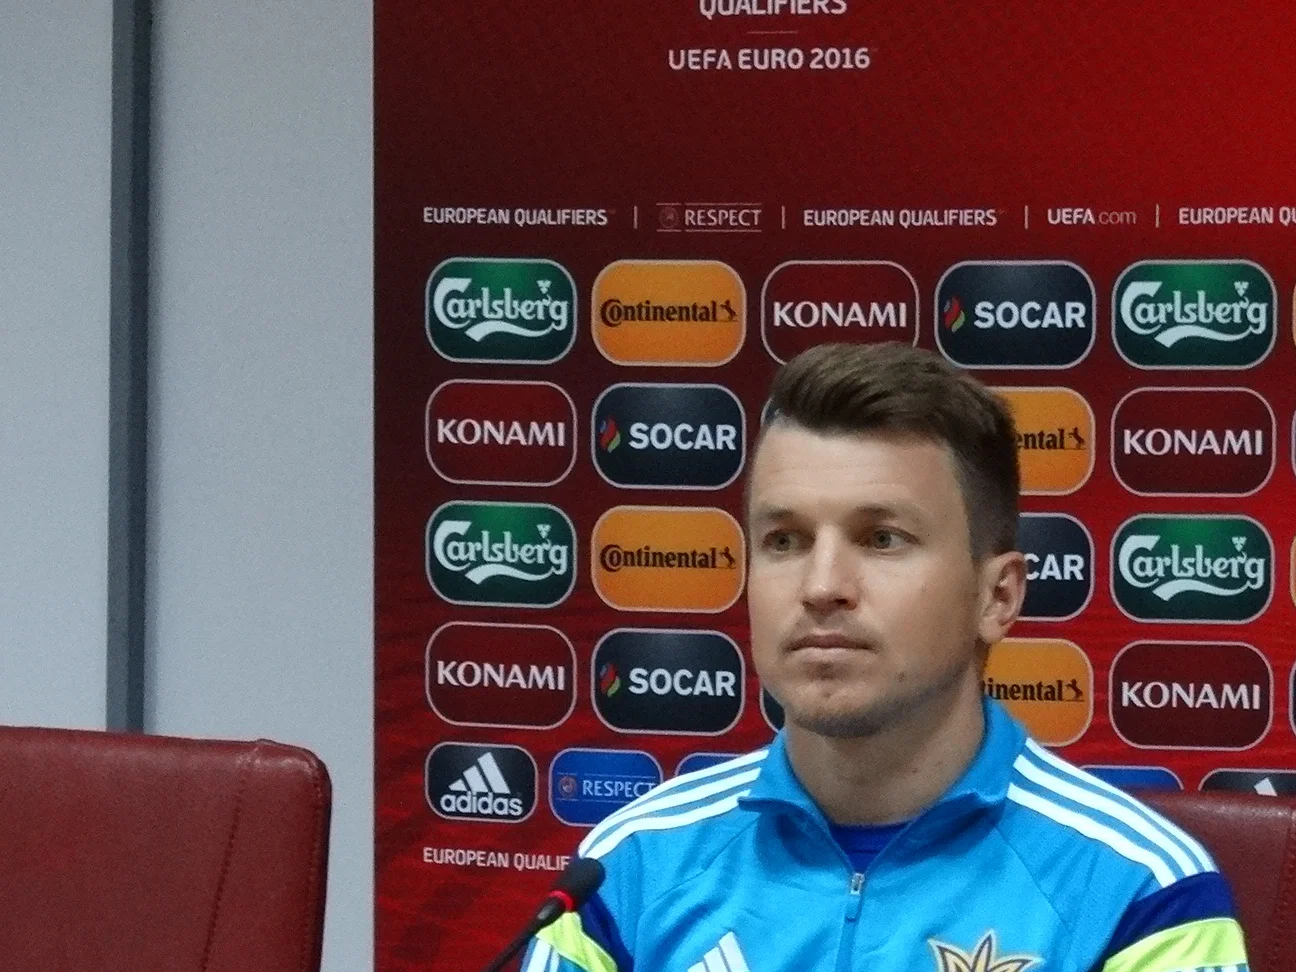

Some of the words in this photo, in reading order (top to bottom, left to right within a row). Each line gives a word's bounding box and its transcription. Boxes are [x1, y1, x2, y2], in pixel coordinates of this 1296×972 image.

[699, 0, 848, 20] QUALIFIERS
[668, 49, 733, 70] UEFA
[738, 48, 804, 70] EURO
[809, 47, 871, 69] 2016
[423, 207, 510, 226] EUROPEAN
[514, 208, 608, 228] QUALIFIERS
[685, 209, 762, 227] RESPECT
[803, 209, 895, 227] EUROPEAN
[899, 209, 998, 229] QUALIFIERS
[1178, 207, 1274, 225] EUROPEAN
[433, 277, 568, 341] Carlsberg
[600, 298, 718, 327] Continental
[773, 301, 907, 329] KONAMI
[974, 301, 1086, 329] SOCAR
[1120, 281, 1267, 348] Carlsberg
[437, 419, 566, 447] KONAMI
[629, 423, 736, 450] SOCAR
[1123, 428, 1264, 456] KONAMI
[433, 520, 568, 584] Carlsberg
[600, 544, 717, 573] Continental
[1024, 553, 1085, 581] CAR
[1119, 534, 1265, 601] Carlsberg
[437, 660, 565, 691] KONAMI
[629, 667, 736, 697] SOCAR
[1121, 681, 1260, 710] KONAMI
[440, 791, 523, 816] adidas
[423, 847, 508, 868] EUROPEAN
[514, 852, 570, 871] QUALIF
